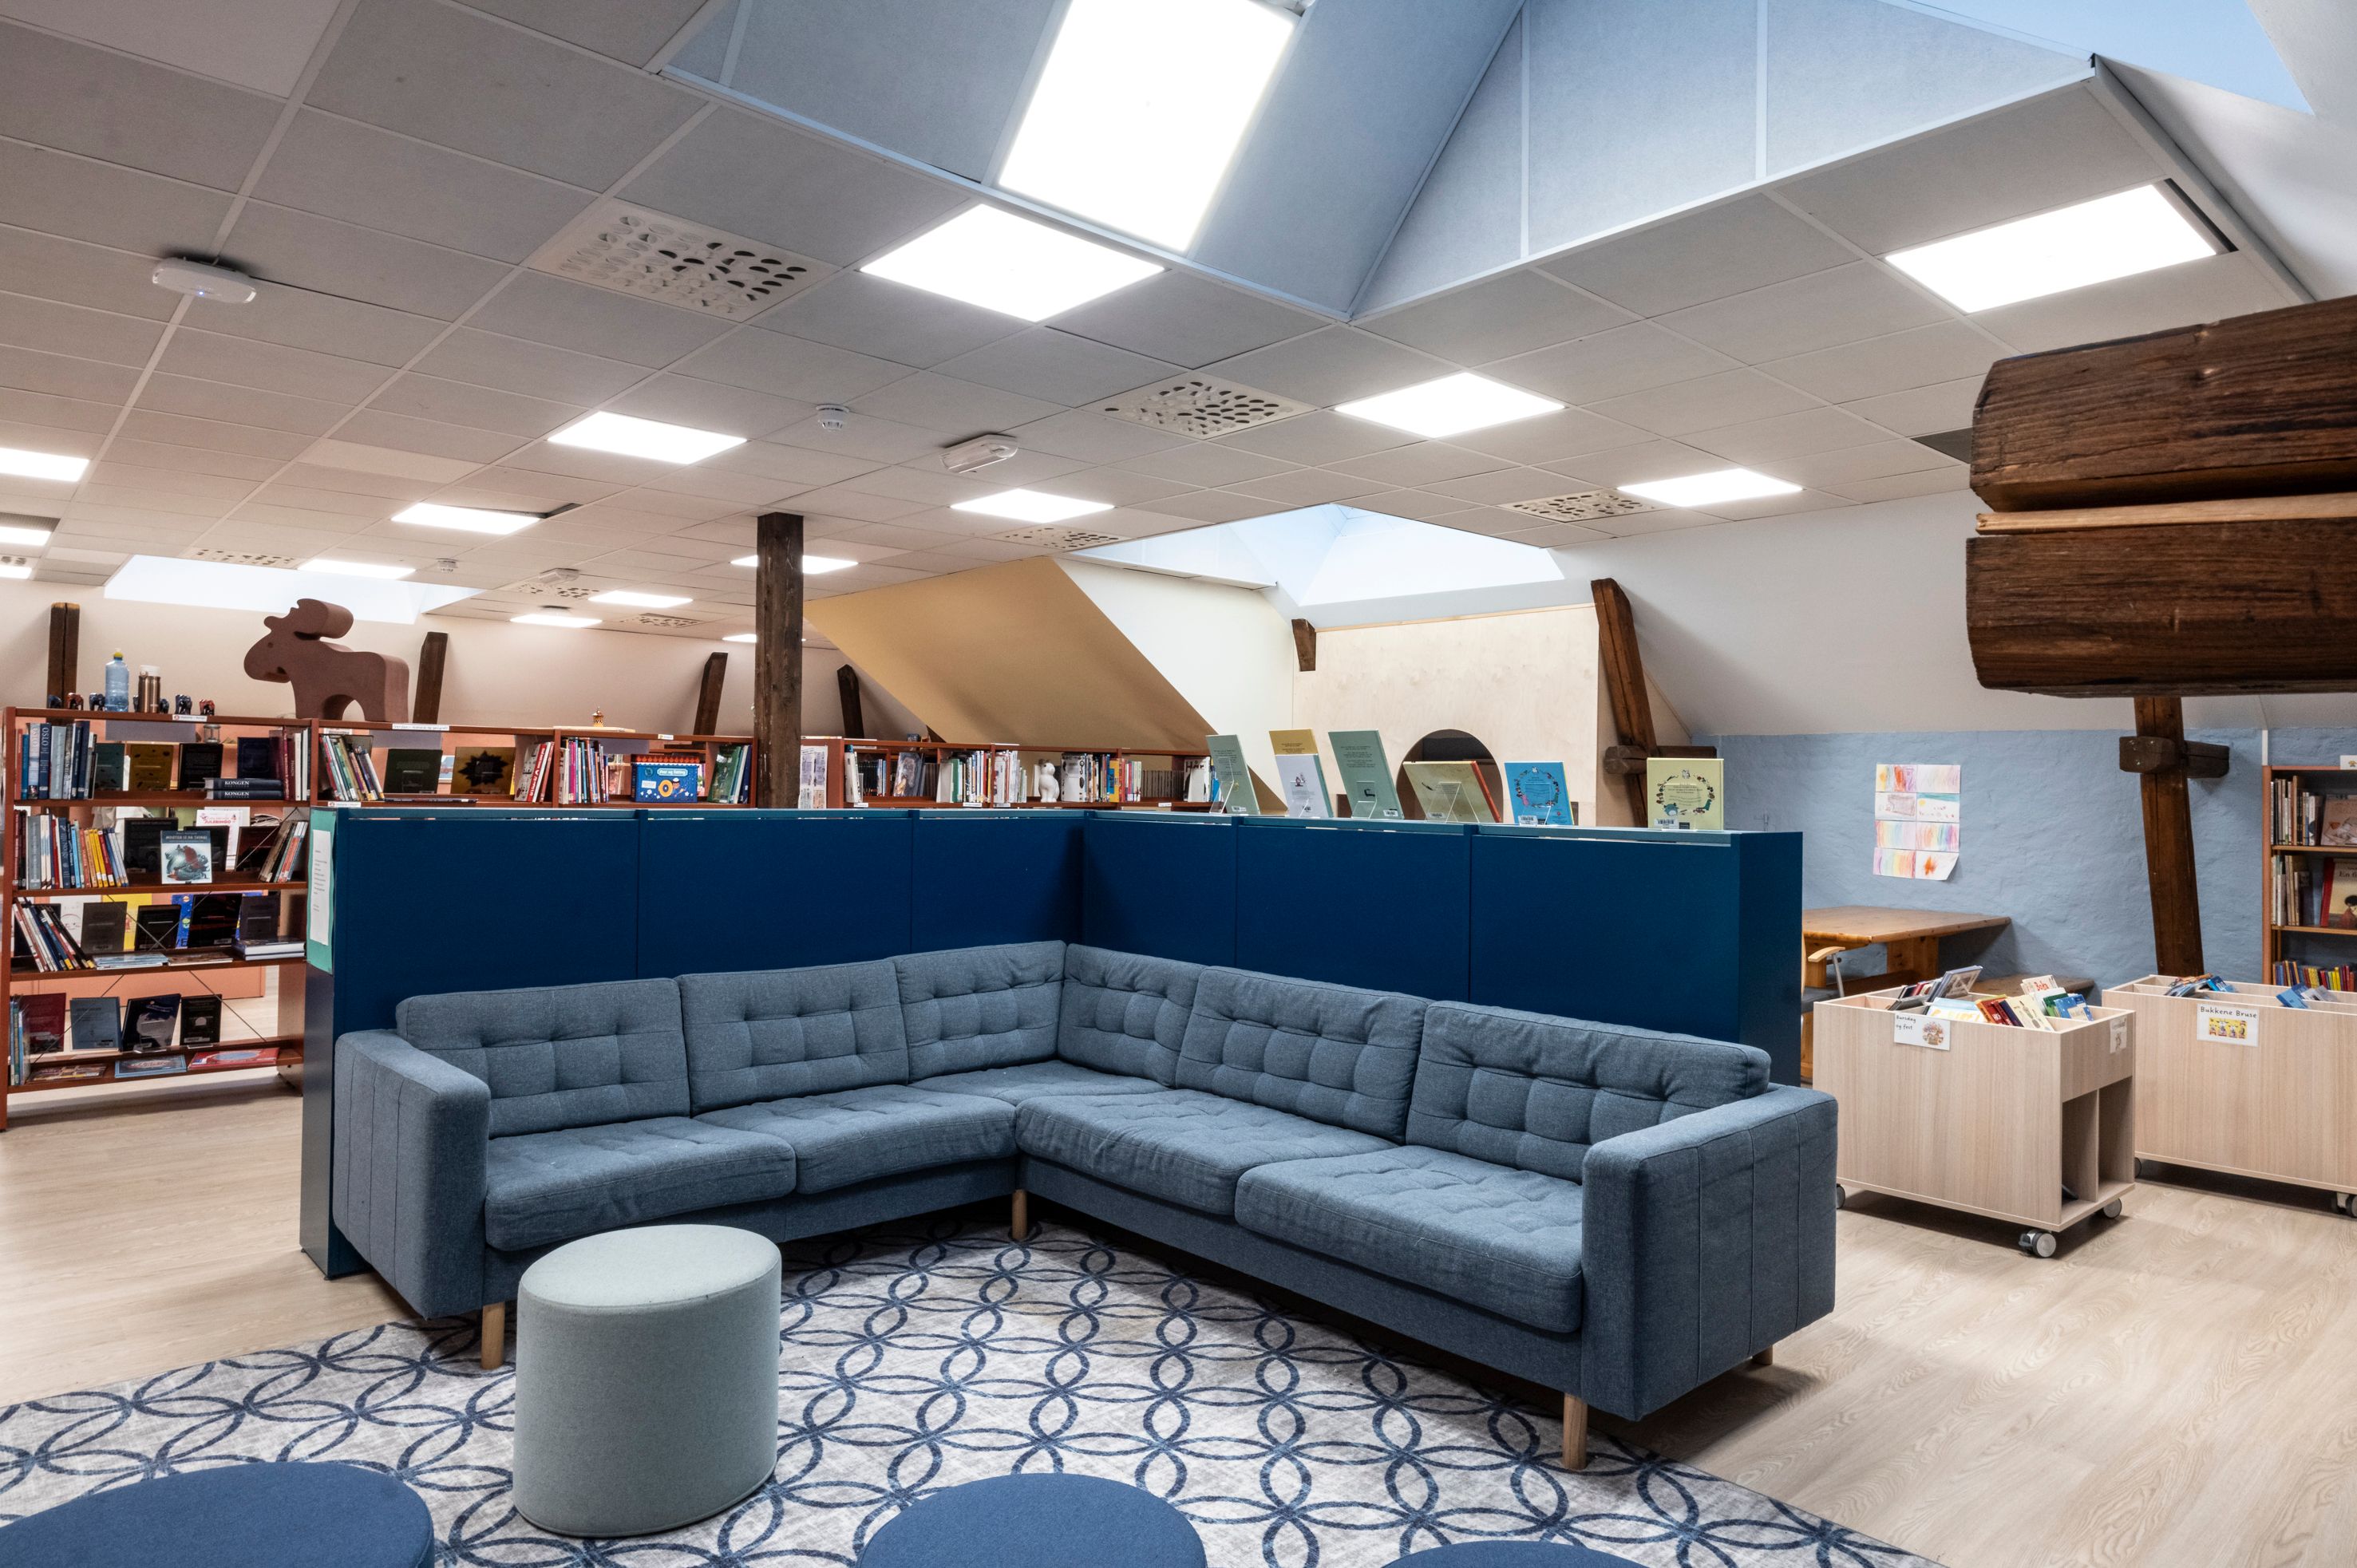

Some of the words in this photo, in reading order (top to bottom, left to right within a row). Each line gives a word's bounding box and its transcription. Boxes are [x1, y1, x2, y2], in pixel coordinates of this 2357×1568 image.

[1185, 760, 1204, 773] Hår
[2201, 1006, 2233, 1016] Bukkene
[2236, 1009, 2257, 1018] Bruse
[1896, 1015, 1916, 1024] Bursdag
